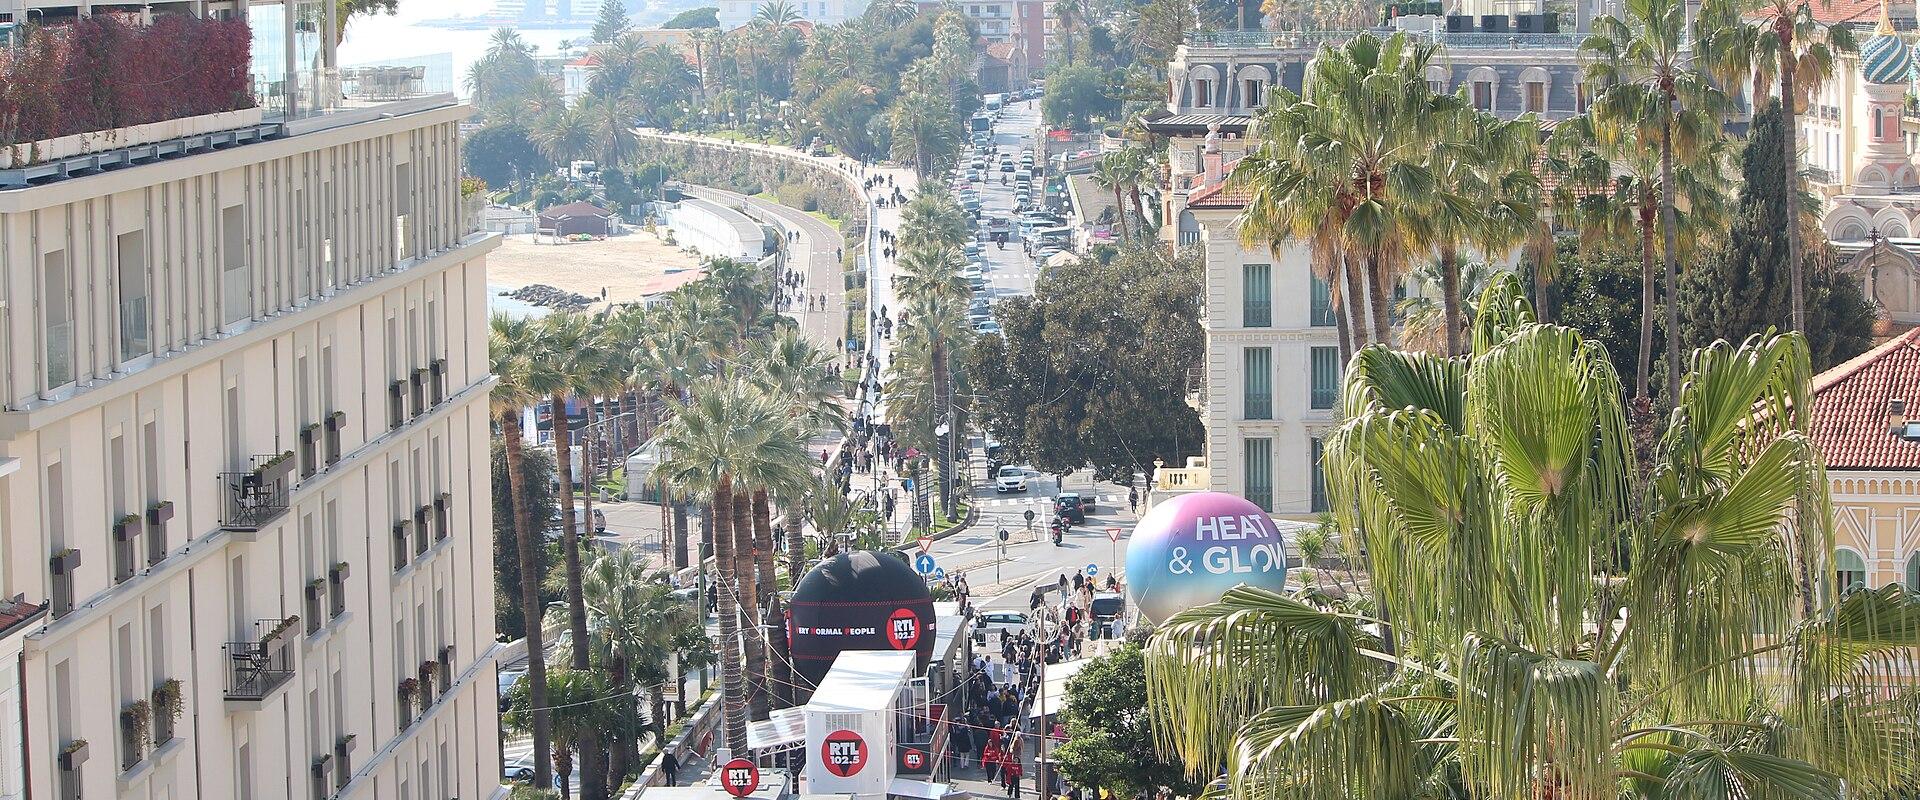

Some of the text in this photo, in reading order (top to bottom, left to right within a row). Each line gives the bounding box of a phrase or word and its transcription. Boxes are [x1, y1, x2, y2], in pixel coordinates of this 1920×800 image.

[1196, 514, 1269, 541] HEAT
[1168, 540, 1287, 575] & GLOW
[893, 619, 915, 631] RTL
[811, 627, 842, 635] NORMAL
[845, 627, 876, 635] PEOPLE
[894, 631, 915, 640] 102.5
[829, 742, 860, 756] RTL
[830, 756, 860, 765] 102.5
[728, 769, 751, 780] RTL
[729, 779, 752, 787] 102.5
